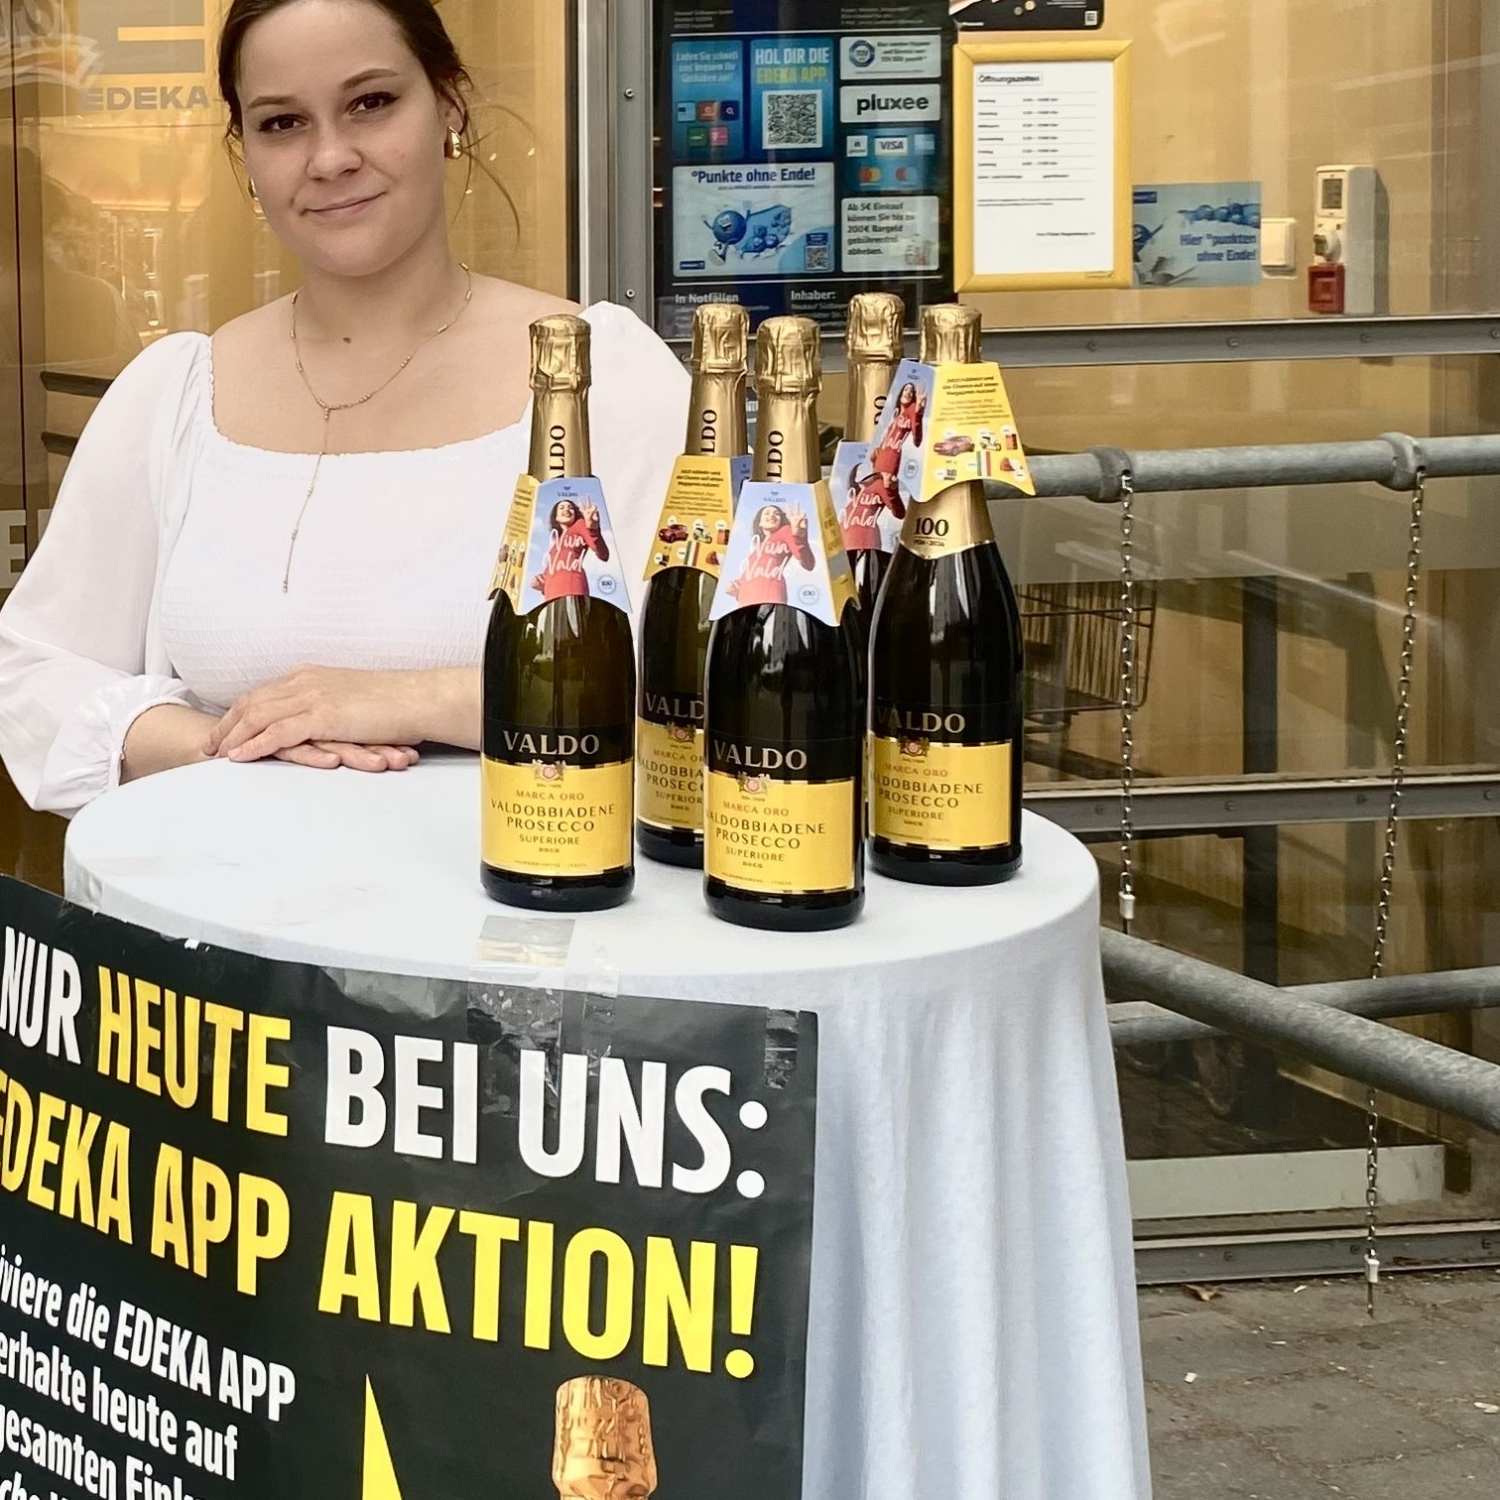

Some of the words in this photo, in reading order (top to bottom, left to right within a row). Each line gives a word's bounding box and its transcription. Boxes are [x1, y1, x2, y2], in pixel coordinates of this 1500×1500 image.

[755, 48, 781, 65] HOL
[783, 48, 806, 64] DIR
[809, 47, 830, 63] DIE
[83, 85, 211, 112] EDEKA
[856, 94, 929, 115] pluxee
[879, 140, 905, 150] VISA
[746, 169, 777, 182] ohne
[780, 168, 816, 182] Ende!
[847, 202, 860, 211] Ab
[878, 213, 890, 221] Sie
[847, 224, 869, 233] 200€
[872, 223, 903, 235] Bargeld
[1180, 234, 1203, 246] Hier
[675, 294, 686, 304] In
[790, 290, 836, 301] Inhaber:
[701, 409, 717, 454] LDO
[550, 424, 566, 478] LDO
[767, 430, 784, 483] LDO
[914, 517, 949, 536] 100
[503, 731, 600, 755] VALDO
[714, 739, 808, 771] VALDO
[923, 766, 948, 778] ORO
[646, 773, 704, 792] PROSEC
[516, 790, 554, 801] MARCA
[560, 792, 585, 801] ORO
[878, 788, 960, 809] PROSECCO
[491, 798, 615, 818] VALDOBBIADENE
[723, 801, 759, 814] MARCA
[764, 806, 790, 817] ORO
[887, 805, 945, 820] SUPERIORE
[507, 816, 595, 832] PROSECCO
[706, 811, 827, 835] ALDOBBIADENE
[519, 834, 580, 845] SUPERIORE
[716, 827, 801, 849] PROSECCO
[725, 846, 785, 861] SUPERIORE
[96, 965, 291, 1137] HEUTE
[325, 1025, 480, 1166] BEI
[518, 1049, 769, 1200] UNS:
[151, 1143, 291, 1296] APP
[317, 1191, 760, 1380] AKTION!
[66, 1282, 110, 1349] die
[113, 1300, 212, 1397] EDEKA
[219, 1347, 296, 1422] APP
[92, 1365, 178, 1456] heute
[185, 1424, 238, 1481] auf
